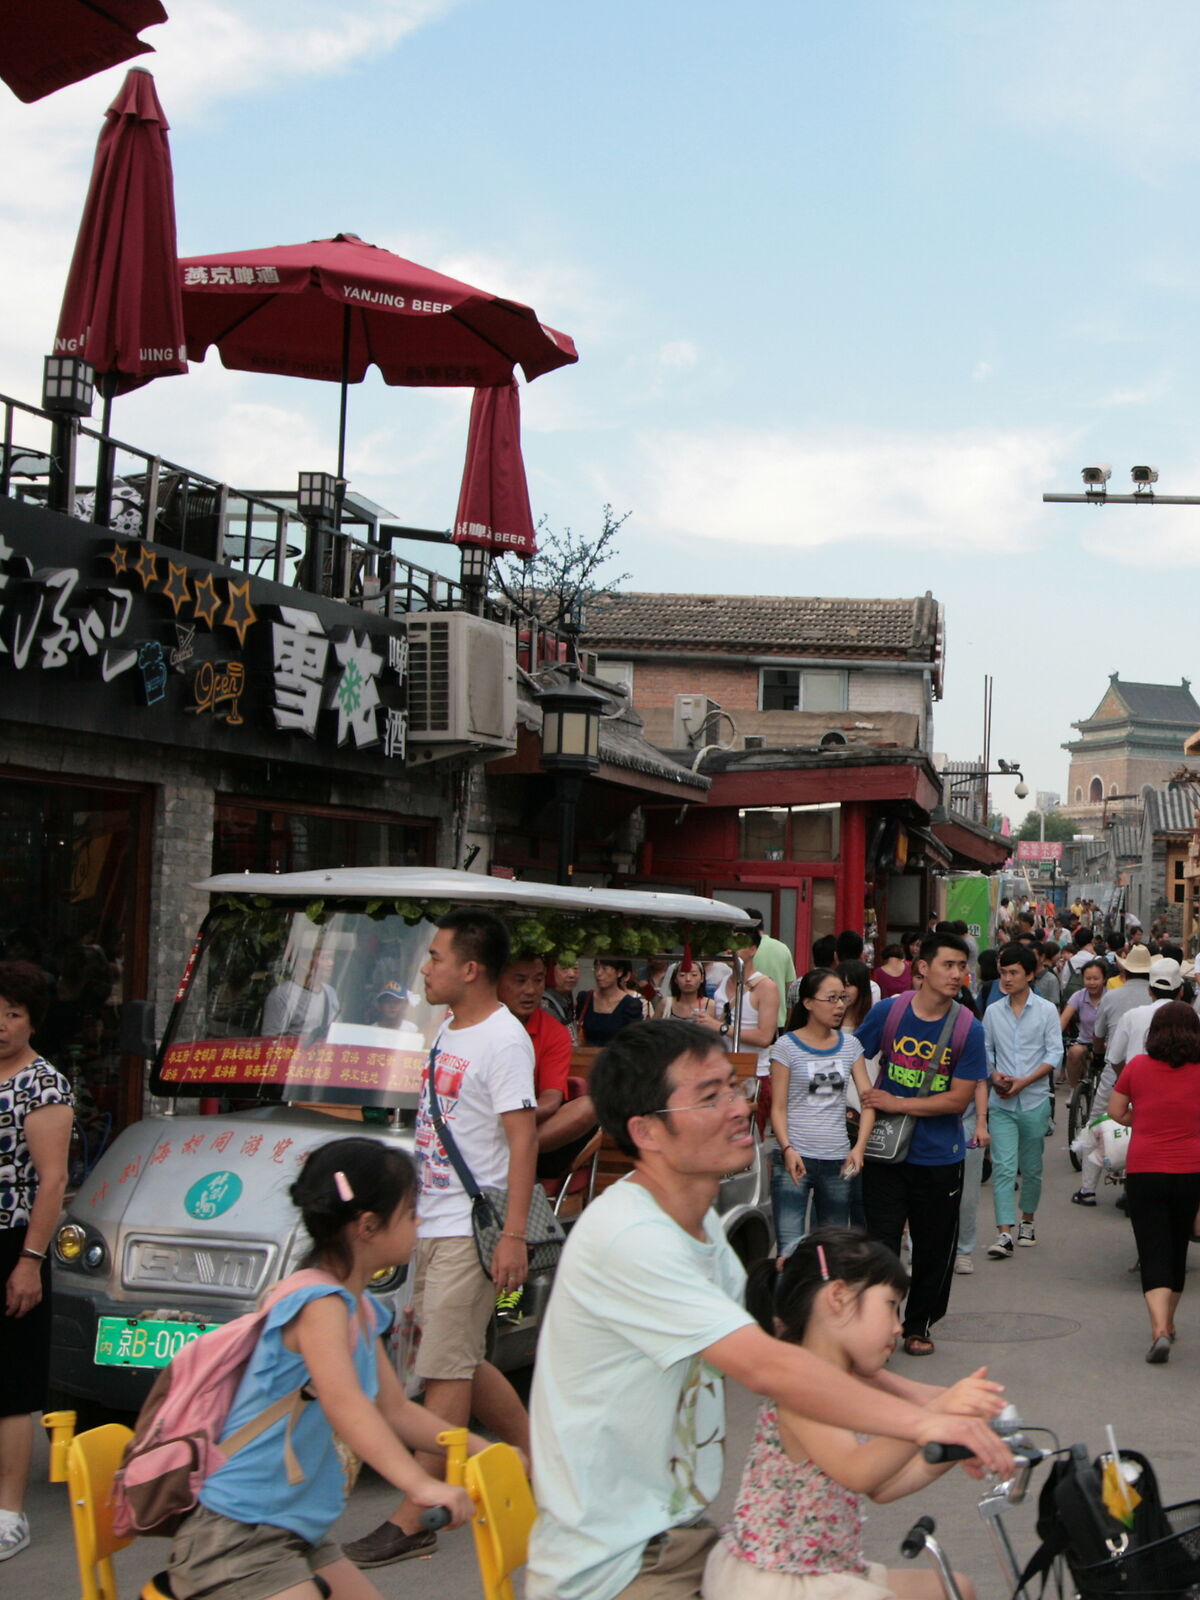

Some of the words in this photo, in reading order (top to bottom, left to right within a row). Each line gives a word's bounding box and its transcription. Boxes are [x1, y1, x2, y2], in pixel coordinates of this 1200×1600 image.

[184, 266, 280, 285] 燕京啤酒
[343, 284, 405, 308] YANJING
[494, 532, 526, 545] BEER
[195, 662, 241, 711] Open
[271, 604, 384, 750] 雪花
[893, 1036, 952, 1065] VOGE
